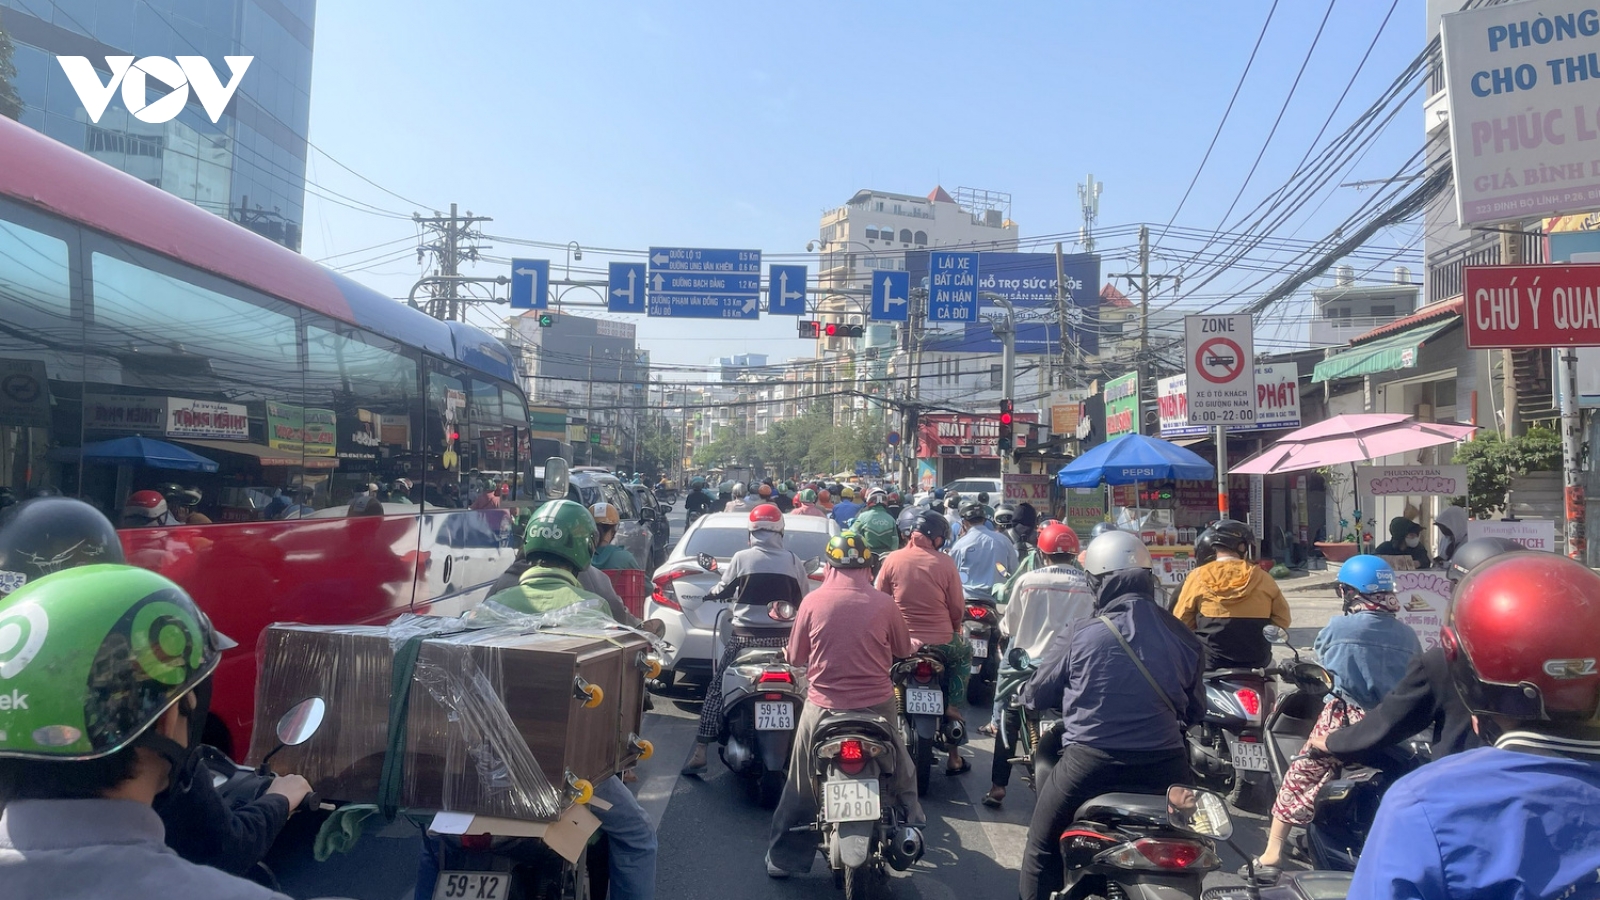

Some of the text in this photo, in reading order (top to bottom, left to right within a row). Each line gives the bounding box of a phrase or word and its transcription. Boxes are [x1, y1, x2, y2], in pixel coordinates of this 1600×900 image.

[1488, 9, 1599, 53] PHÒNG
[1471, 63, 1537, 98] CHO
[1471, 105, 1600, 157] PHÚC L
[1473, 167, 1519, 193] GIÁ
[1524, 162, 1585, 187] BÌNH
[695, 251, 702, 259] 13
[739, 252, 748, 261] 0.5
[749, 252, 759, 261] Km
[938, 255, 970, 270] LÁI XE
[739, 263, 748, 271] 0.6
[749, 263, 759, 272] Km
[739, 280, 747, 288] 1.2
[748, 280, 758, 289] Km
[934, 270, 974, 286] BẤT CẨN
[979, 273, 996, 289] HỖ
[998, 279, 1021, 291] TRỢ
[1022, 276, 1047, 290] SỨC
[723, 298, 731, 306] 1.3
[732, 298, 742, 306] Km
[936, 288, 972, 306] ÂN HẬN
[1475, 276, 1521, 331] CHÚ
[1527, 276, 1542, 330] Ý
[723, 309, 731, 317] 0.6
[732, 309, 742, 317] Km
[937, 304, 969, 319] CẢ ĐỜI
[1201, 317, 1235, 333] ZONE
[1224, 389, 1247, 397] KHÁCH
[1257, 376, 1297, 410] PHÁT
[1195, 399, 1204, 407] CÓ
[938, 416, 1000, 437] MẮT KÍN
[1122, 468, 1154, 477] PEPSI
[1033, 484, 1048, 498] XE
[1370, 476, 1456, 495] SANDWICH
[871, 518, 890, 526] Grab
[529, 524, 563, 540] Grab
[1542, 658, 1598, 677] GRZ
[912, 691, 937, 702] 59-S1
[760, 704, 788, 715] 59-X3
[909, 702, 942, 713] 260.52
[758, 717, 791, 729] 774.63
[1234, 756, 1268, 770] 961.75
[833, 783, 871, 801] 94-L1
[834, 801, 872, 818] 7080
[445, 875, 499, 899] 59-X2
